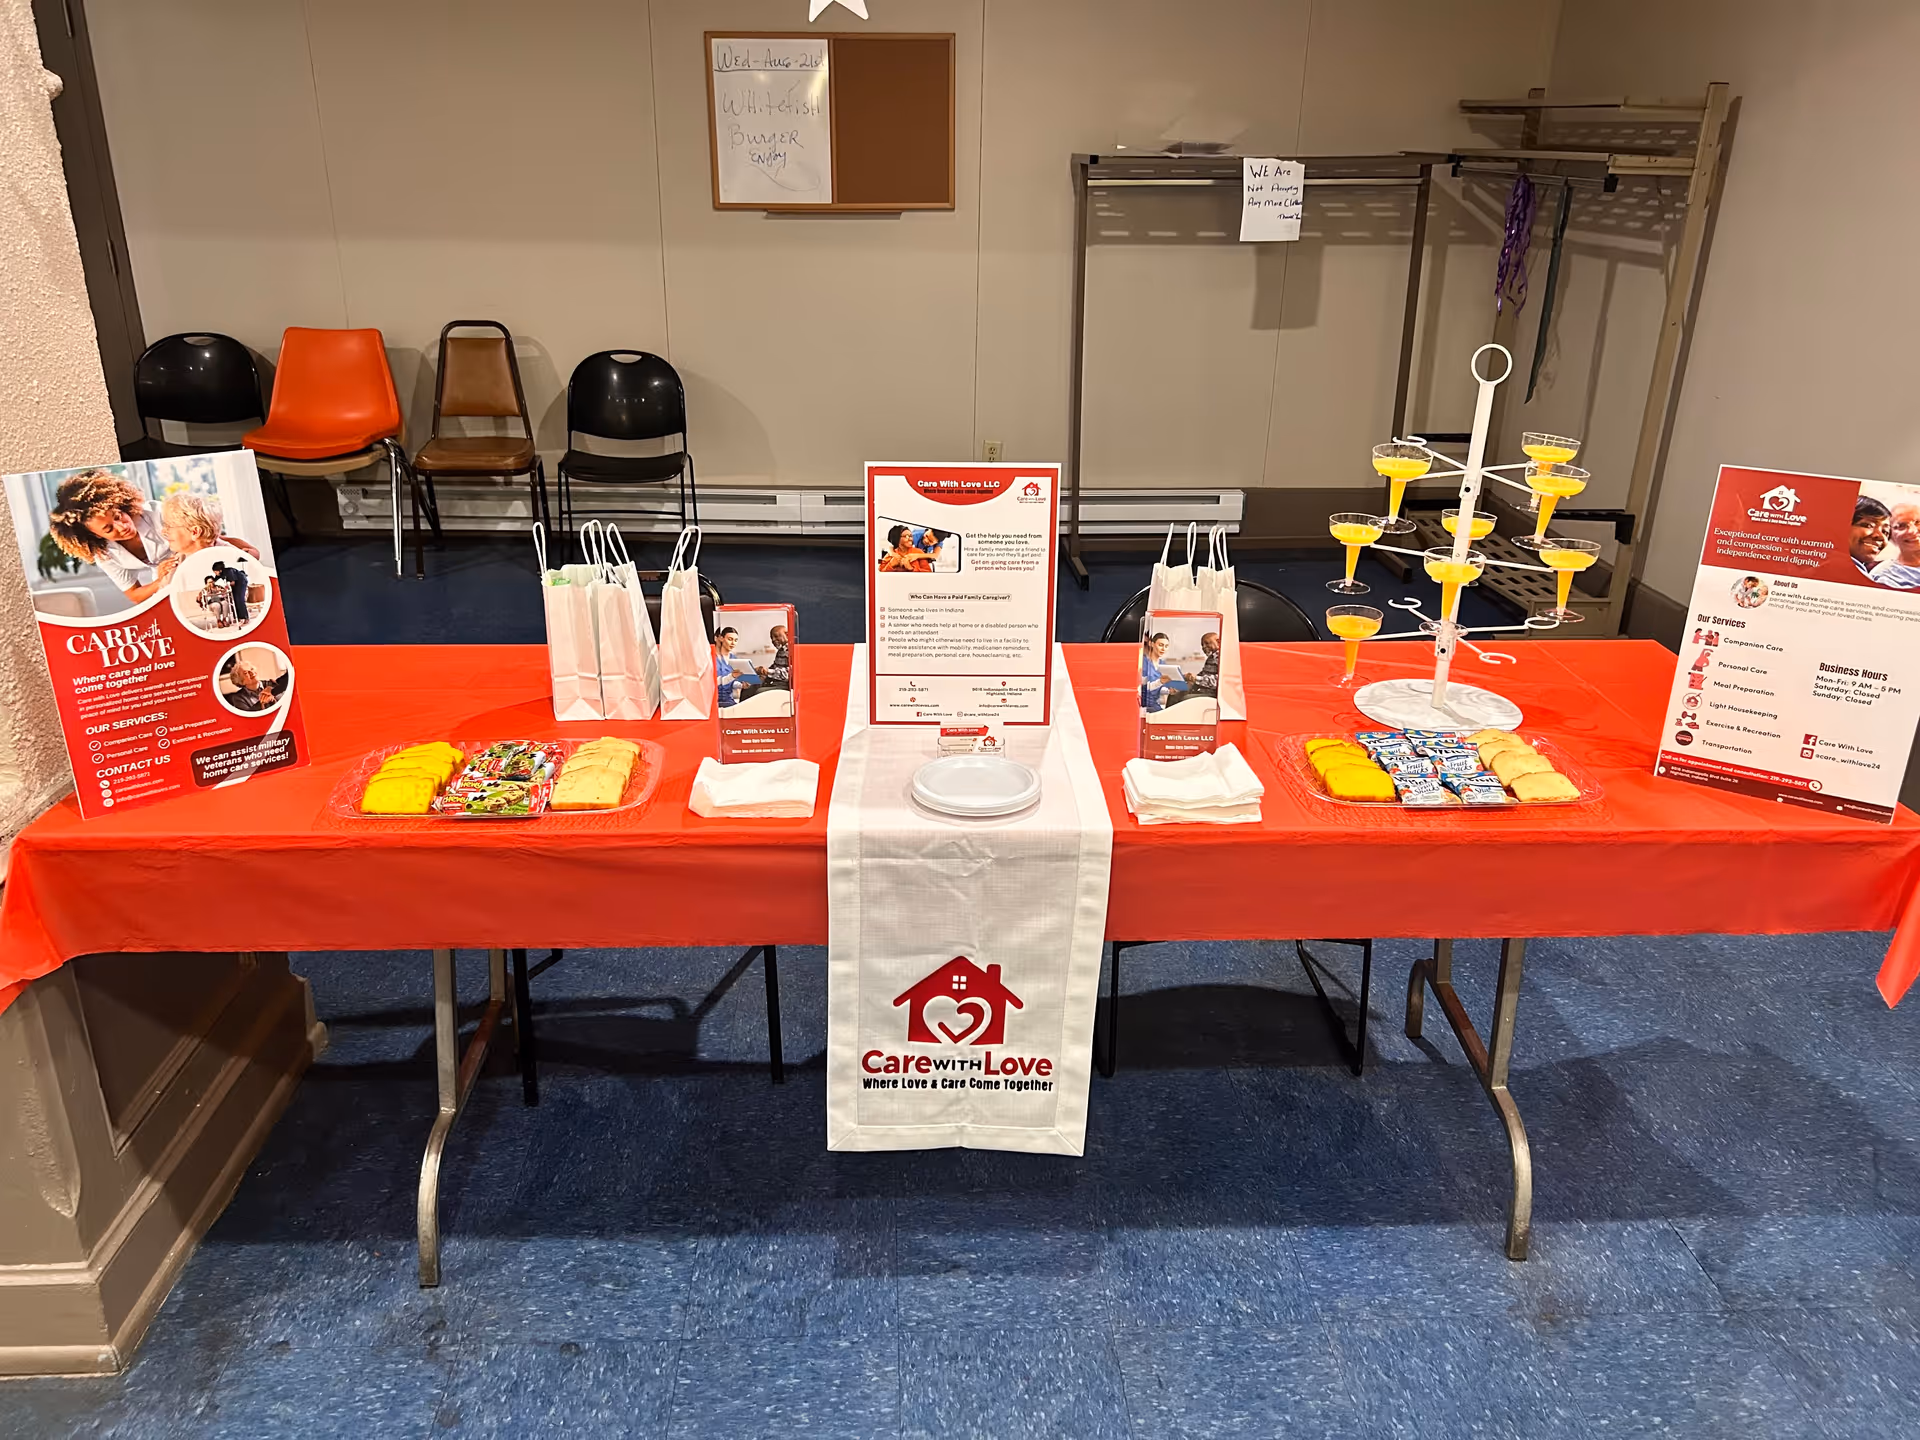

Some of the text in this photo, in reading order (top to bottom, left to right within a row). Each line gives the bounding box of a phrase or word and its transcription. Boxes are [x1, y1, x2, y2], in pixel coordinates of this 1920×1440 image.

[1747, 508, 1769, 518] Care
[1784, 514, 1807, 523] Love
[1714, 527, 1834, 549] Exceptional care with warmth
[1716, 538, 1827, 559] and compassion ensuring
[1716, 546, 1820, 568] independence and dignity.
[1773, 580, 1790, 588] About
[1697, 613, 1747, 629] Our Services
[66, 618, 162, 655] CARE with
[1723, 637, 1784, 652] Companion Care
[100, 637, 175, 668] LOVE
[73, 661, 175, 686] Where care and love
[1718, 661, 1768, 675] Personal Care
[1819, 662, 1888, 682] Business Hours
[75, 675, 148, 694] come together
[1713, 681, 1775, 697] Meal Preparation
[1814, 682, 1881, 699] Saturday: Closed
[1815, 675, 1849, 686] Mon-Fri:
[1858, 682, 1873, 690] AM
[1881, 685, 1886, 693] 5
[1887, 687, 1902, 695] PM
[1812, 690, 1872, 706] Sunday: Closed
[1709, 701, 1778, 720] Light Housekeeping
[86, 712, 168, 735] OUR SERVICES:
[185, 718, 216, 729] Preparation
[1706, 720, 1735, 730] Exercise
[1742, 726, 1781, 739] Recreation
[103, 736, 137, 746] Companion
[172, 735, 196, 744] Exercise
[203, 727, 232, 737] Recreation
[106, 749, 133, 759] Personal
[195, 737, 290, 765] We can assist military
[1702, 739, 1752, 754] Transportation
[1818, 739, 1873, 755] Care With Love
[96, 754, 171, 778] CONTACT US
[203, 752, 289, 779] home care services!
[204, 745, 285, 771] veterans who need
[861, 1050, 1053, 1076] Care WITH Love
[862, 1077, 1053, 1092] Where Love & Care Come Together
